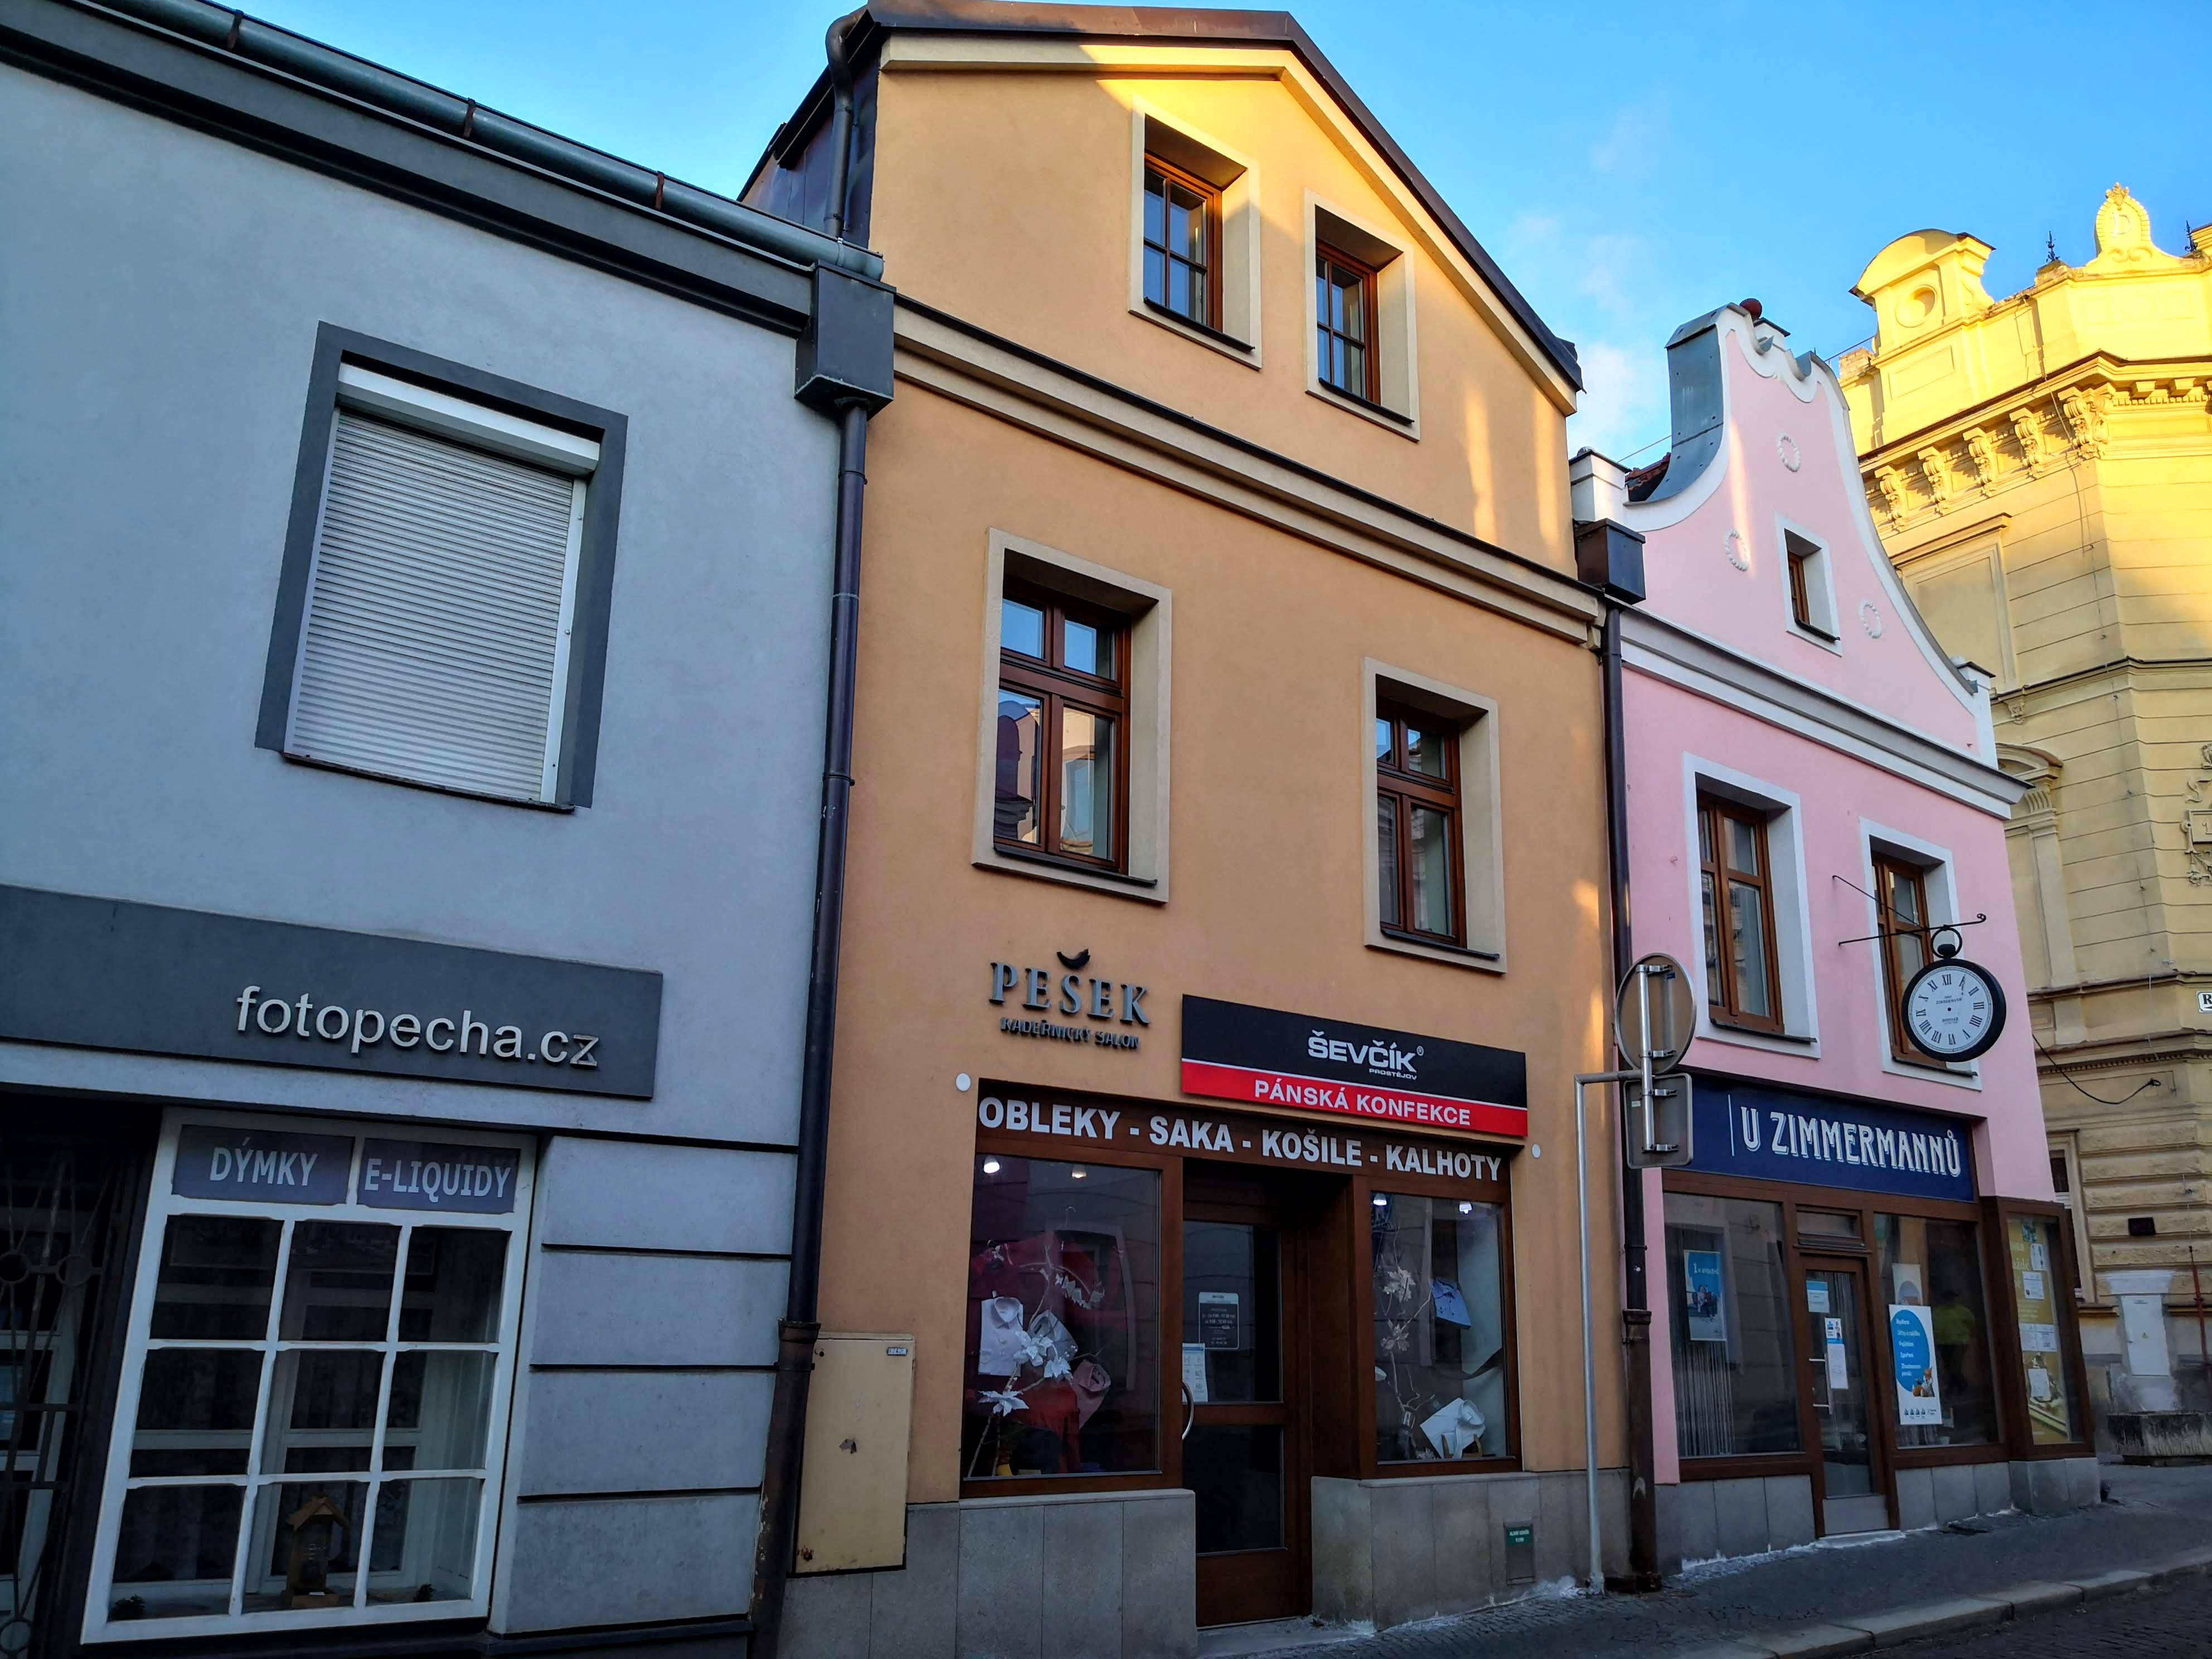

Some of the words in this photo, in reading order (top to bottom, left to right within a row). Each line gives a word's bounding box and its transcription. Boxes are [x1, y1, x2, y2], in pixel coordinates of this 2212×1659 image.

[989, 949, 1150, 1026] PEŠEK
[236, 986, 599, 1067] fotopecha.cz
[1095, 1031, 1139, 1049] SALON
[1308, 1029, 1417, 1073] ŠEVČÍK
[1254, 1079, 1349, 1110] PÁNSKÁ
[1356, 1094, 1471, 1126] KONFEKCE
[1369, 1068, 1417, 1080] PROSTĚJOV
[209, 1137, 318, 1186] DÝMKY
[364, 1158, 511, 1202] E-LIQUIDY
[979, 1097, 1120, 1139] OBLEKY
[1149, 1116, 1234, 1153] SAKA
[1262, 1128, 1362, 1166] KOŠILE
[1386, 1144, 1501, 1181] KALHOTY
[1740, 1106, 1760, 1152] U
[1770, 1111, 1961, 1177] ZIMMERMANNŮ
